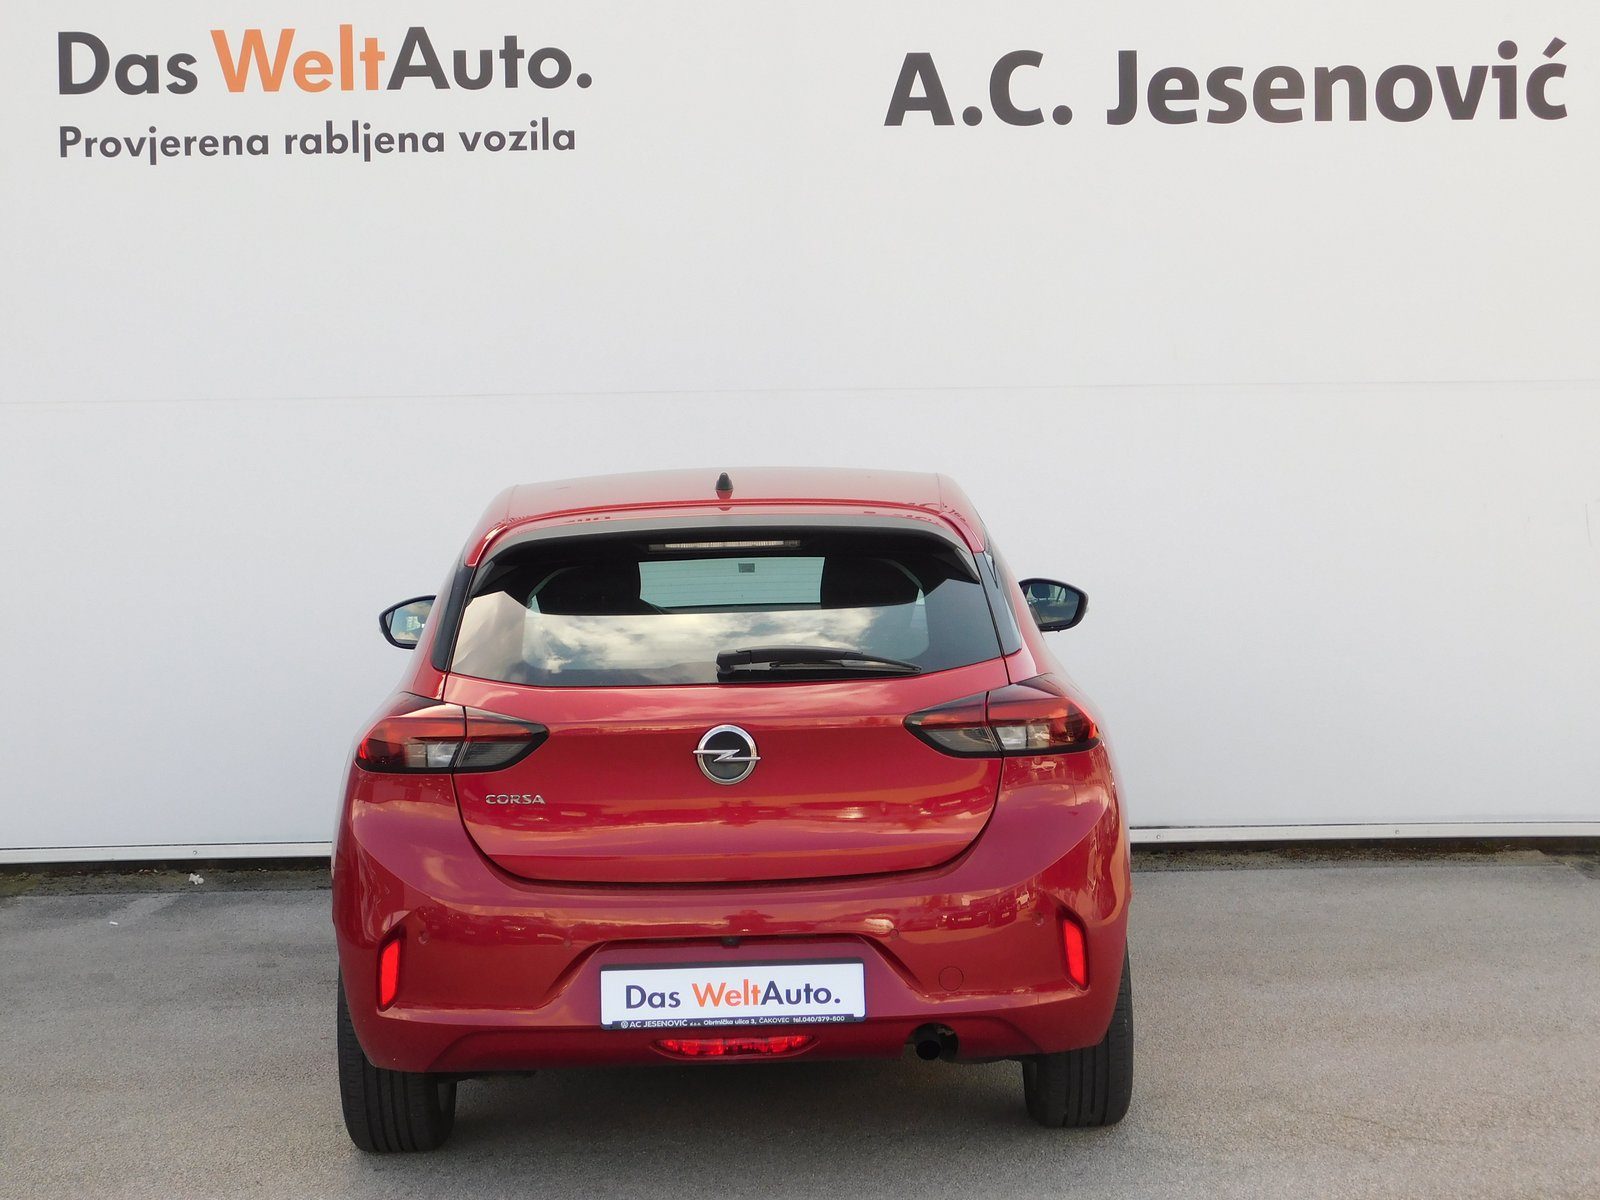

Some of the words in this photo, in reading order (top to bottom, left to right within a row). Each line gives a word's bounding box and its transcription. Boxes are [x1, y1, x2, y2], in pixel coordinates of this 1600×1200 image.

[57, 31, 198, 95] Das
[211, 24, 593, 93] WeltAuto.
[883, 50, 1073, 127] A.C.
[1107, 37, 1567, 125] Jesenović
[59, 126, 269, 165] Provjerena
[284, 120, 446, 162] rabljena
[459, 117, 576, 152] vozila
[485, 794, 545, 805] CORSA
[625, 985, 681, 1009] Das
[692, 979, 841, 1007] WeltAuto.
[629, 1020, 642, 1028] AC
[643, 1019, 688, 1028] JESENOVIĆ
